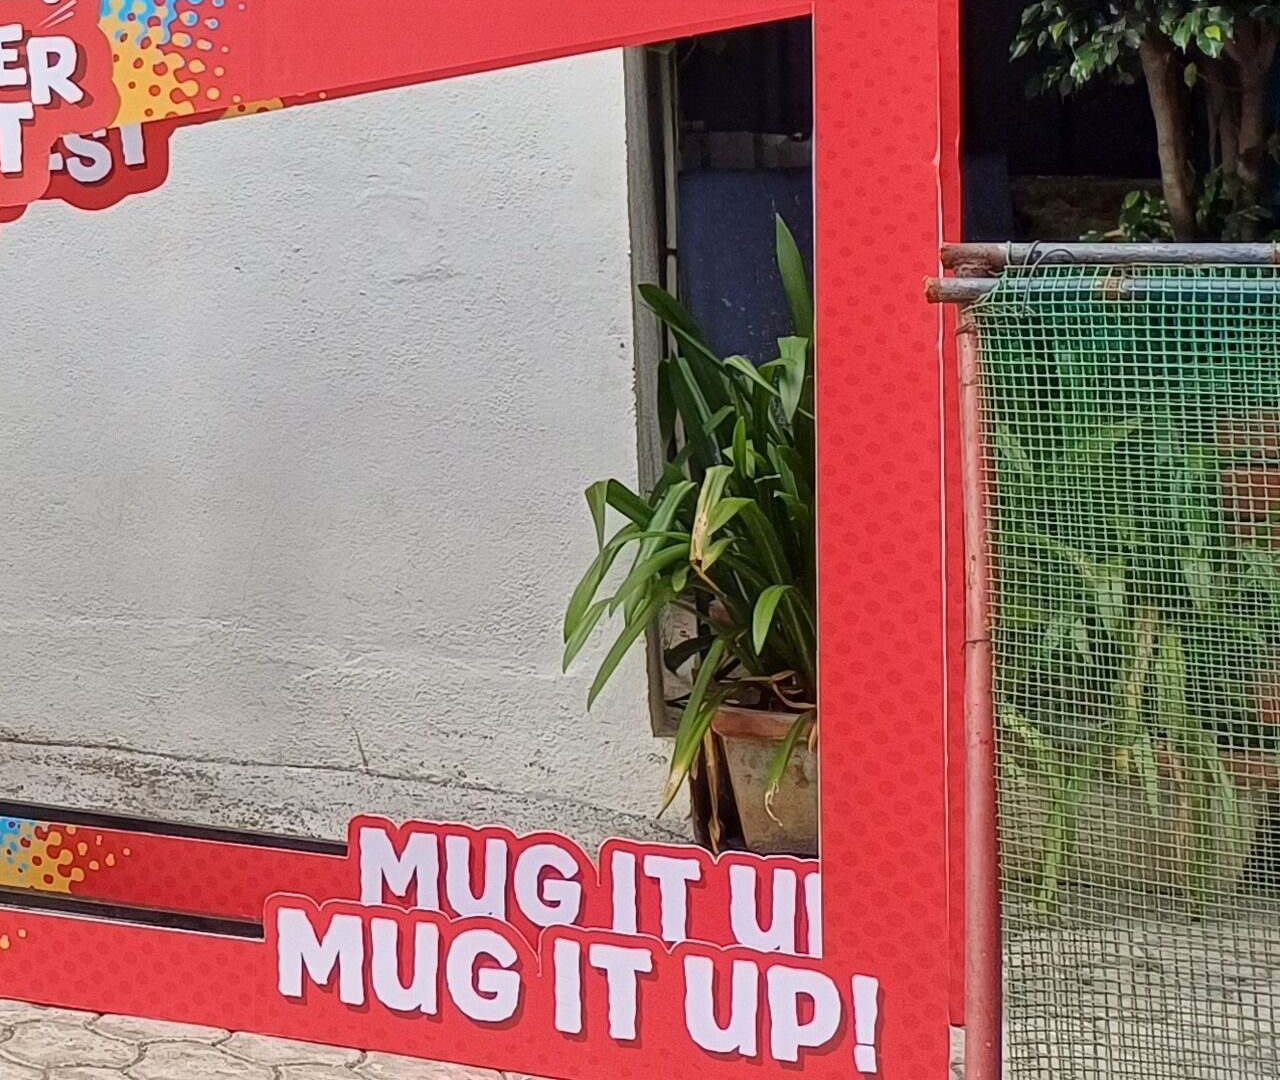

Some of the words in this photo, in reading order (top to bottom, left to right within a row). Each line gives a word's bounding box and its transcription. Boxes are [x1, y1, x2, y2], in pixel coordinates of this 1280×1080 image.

[359, 827, 583, 927] MUG
[611, 851, 702, 943] IT
[277, 908, 521, 1022] MUG
[554, 939, 653, 1039] IT
[684, 955, 880, 1073] UP!
